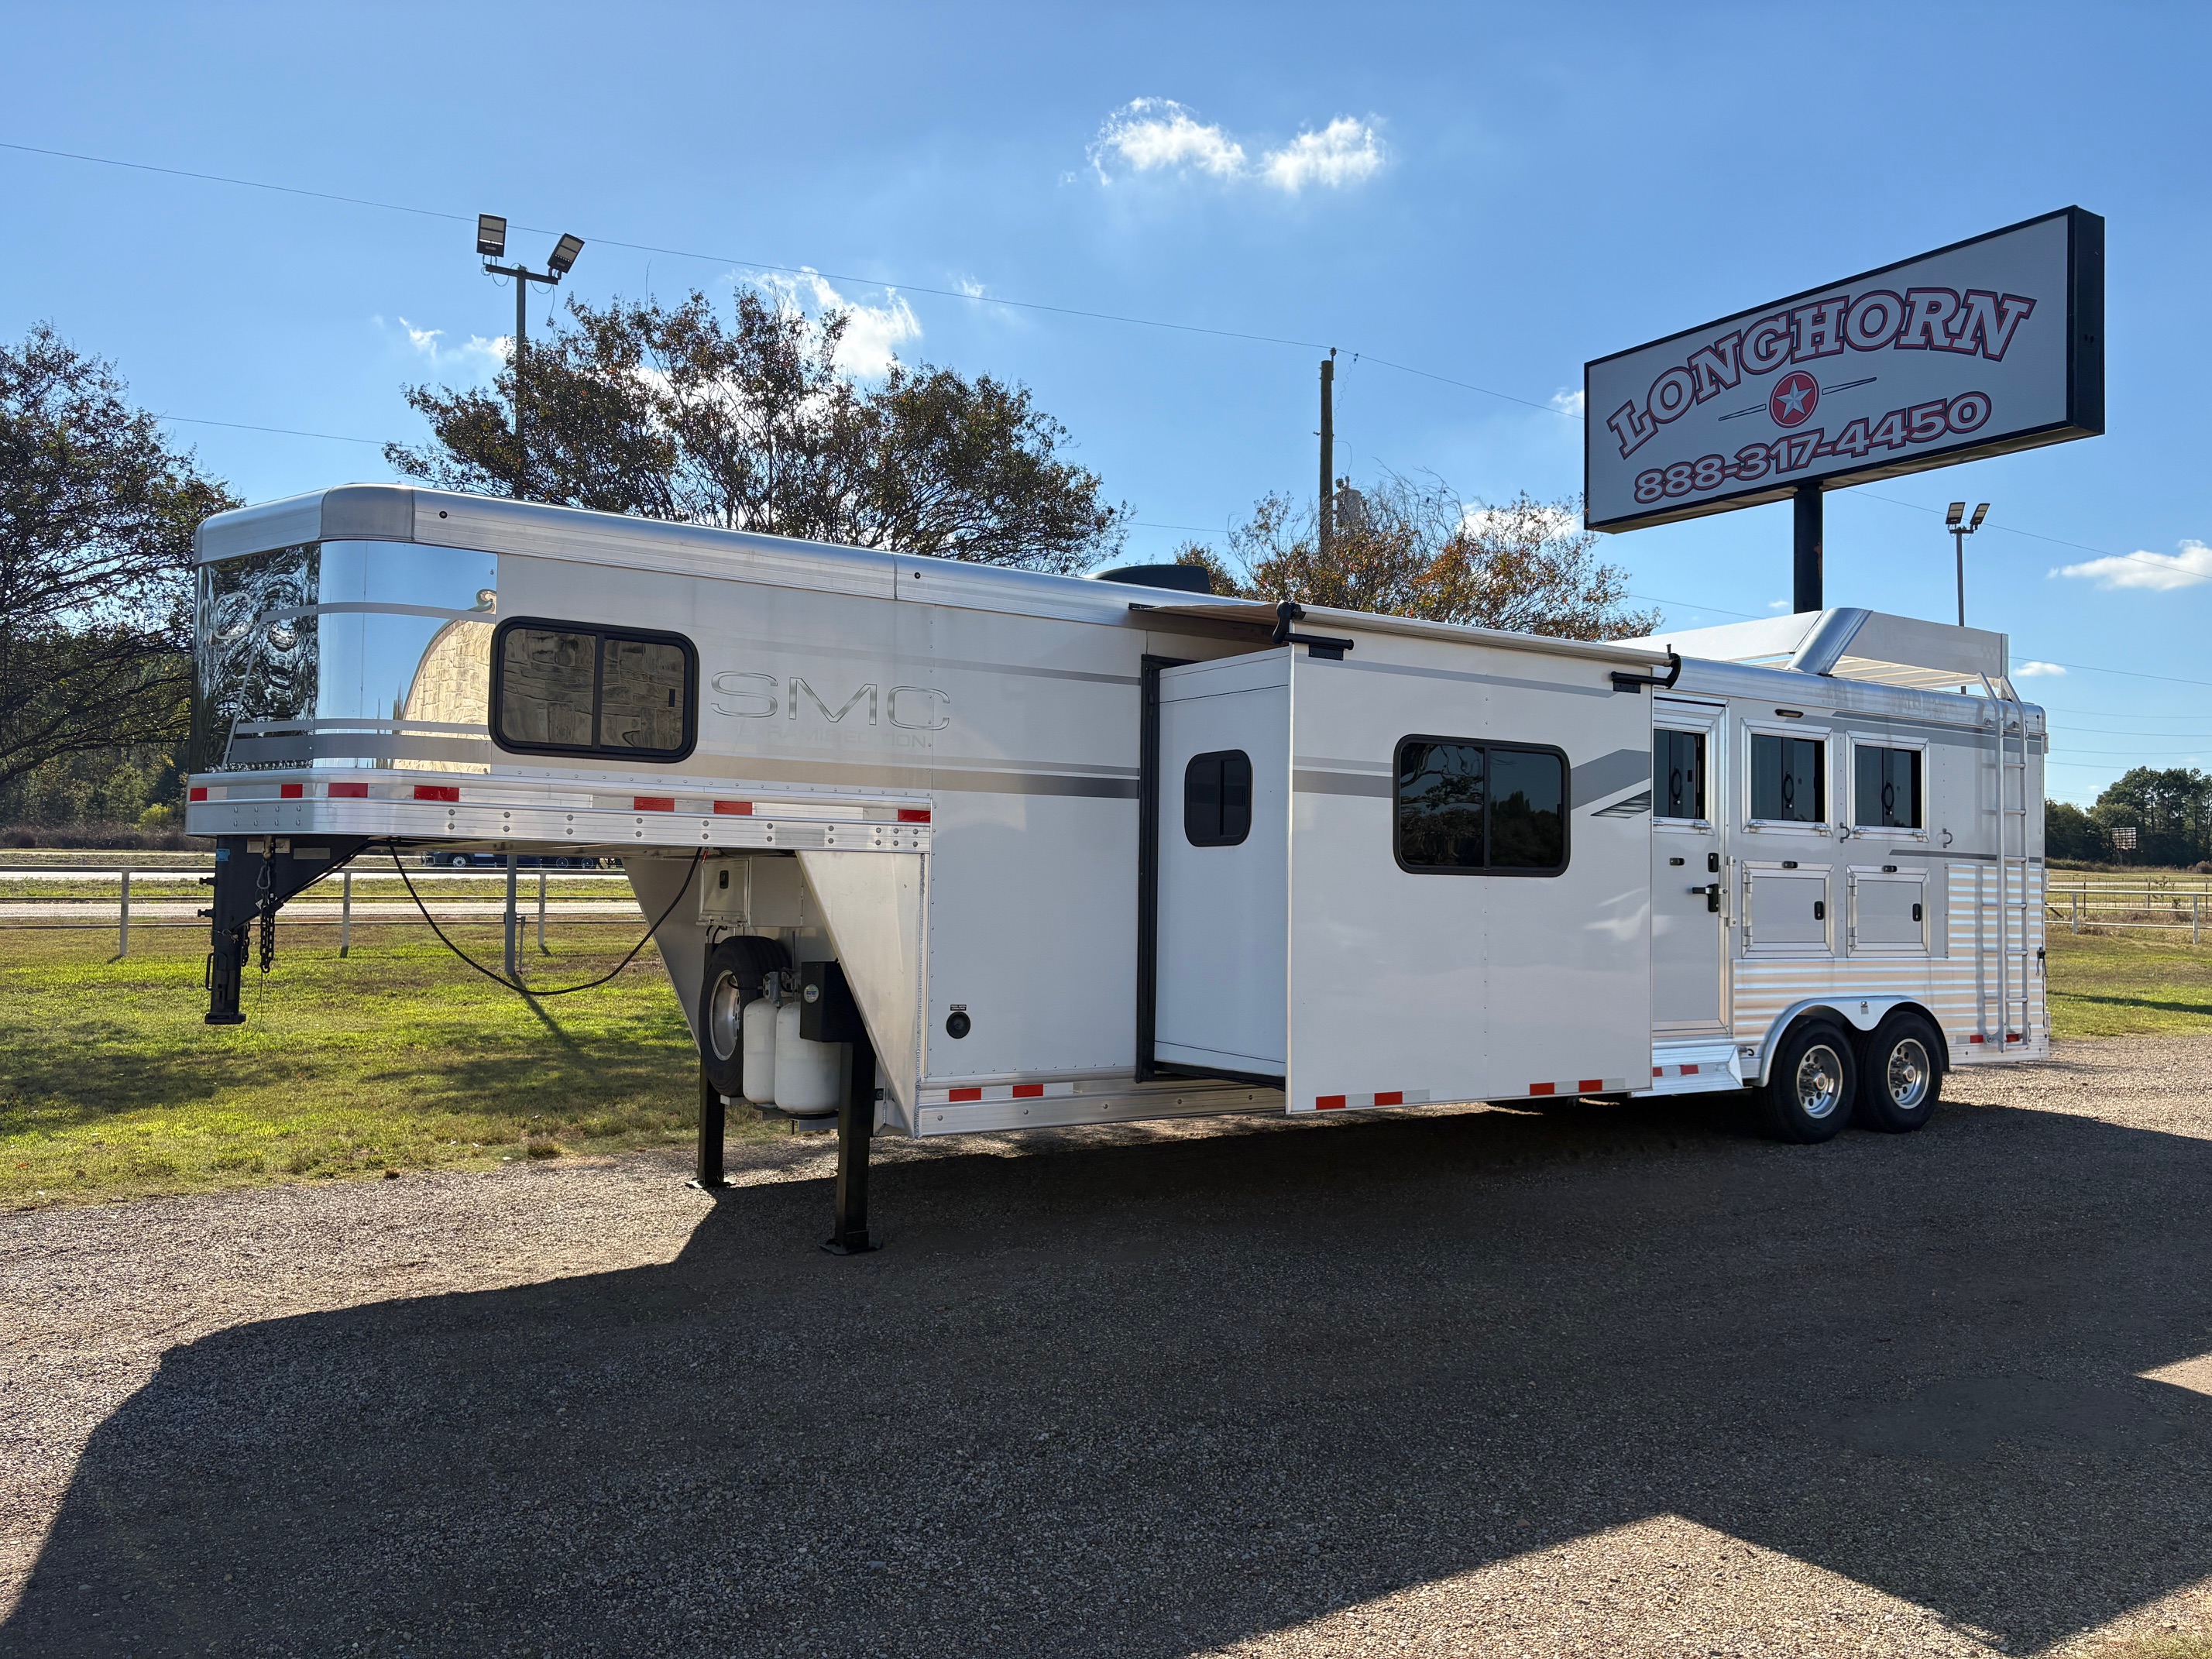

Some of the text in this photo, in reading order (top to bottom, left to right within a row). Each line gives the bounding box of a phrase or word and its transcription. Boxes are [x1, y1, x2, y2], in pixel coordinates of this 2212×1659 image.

[1607, 287, 2038, 459] LONGHORN
[1634, 390, 1992, 504] 888-317-4450
[710, 671, 950, 730] SMC
